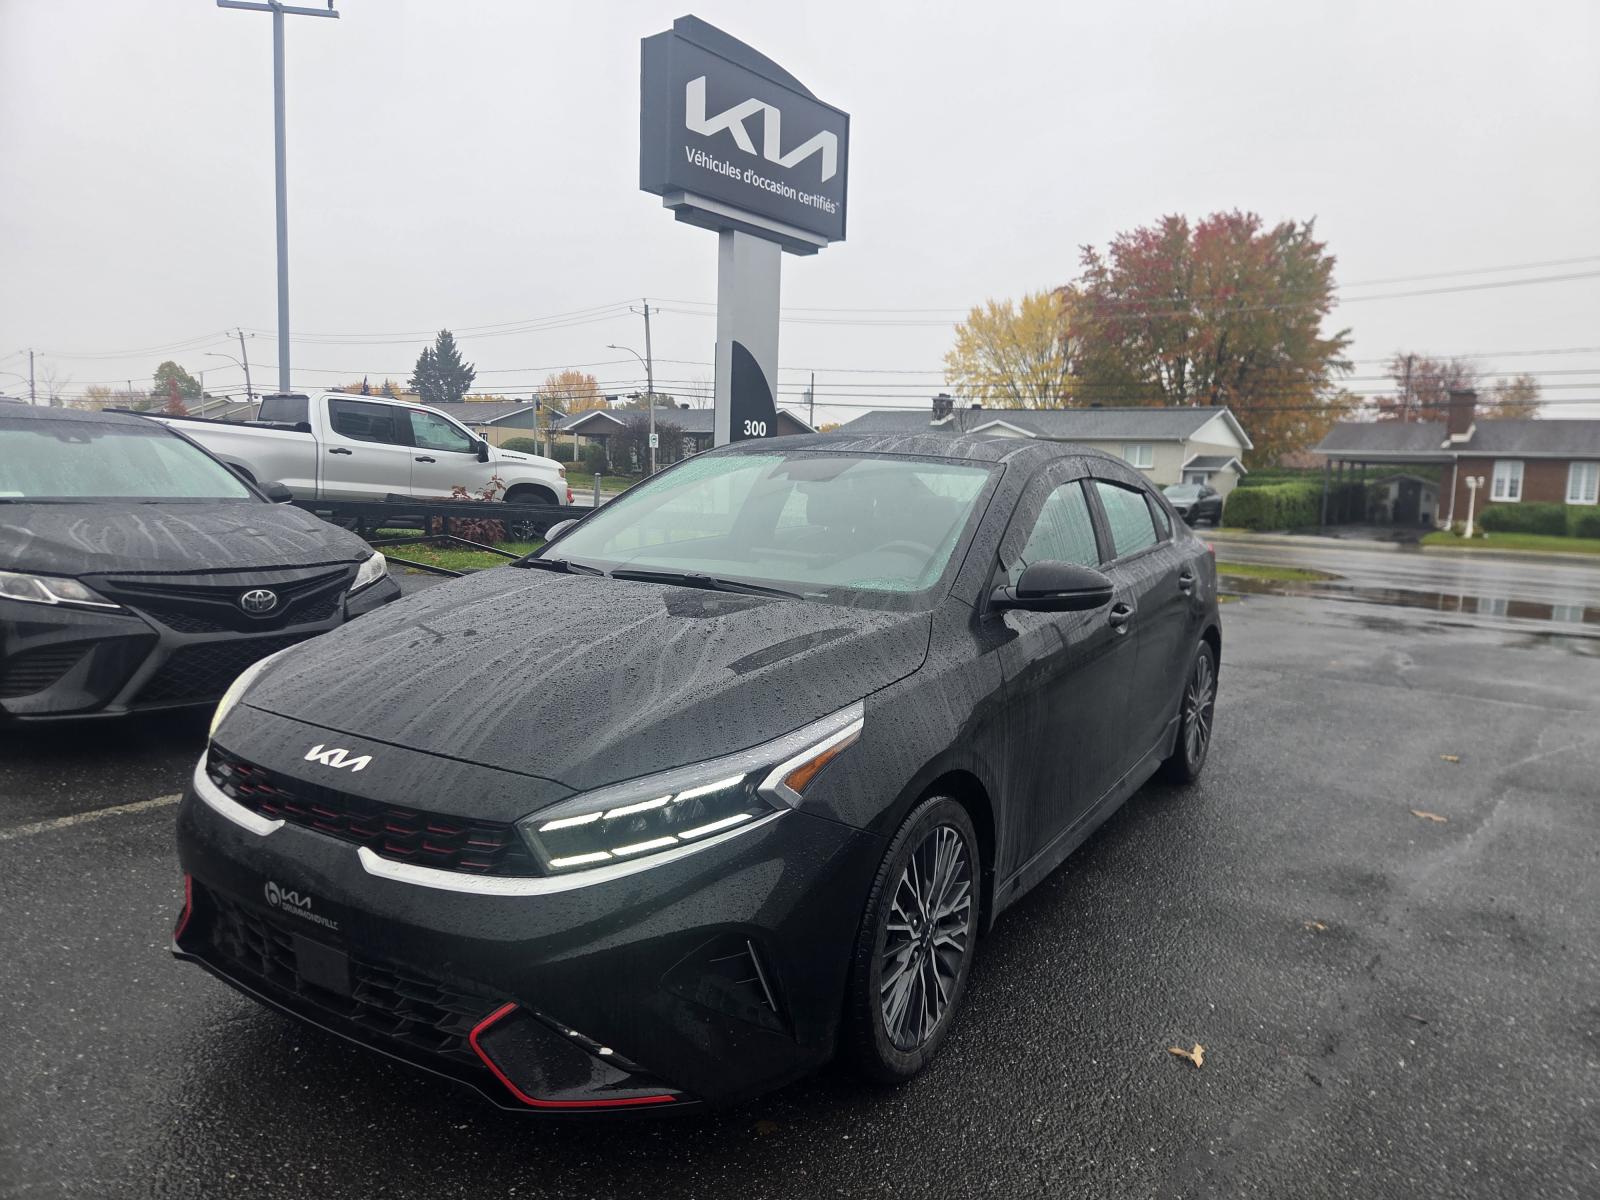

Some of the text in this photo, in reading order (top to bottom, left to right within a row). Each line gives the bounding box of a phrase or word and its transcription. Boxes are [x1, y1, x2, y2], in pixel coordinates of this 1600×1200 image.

[686, 75, 838, 184] KIA
[685, 145, 836, 214] Véhicules d'occasion certifiés
[743, 419, 767, 437] 300
[303, 744, 373, 773] KIA
[281, 887, 312, 909] KIA
